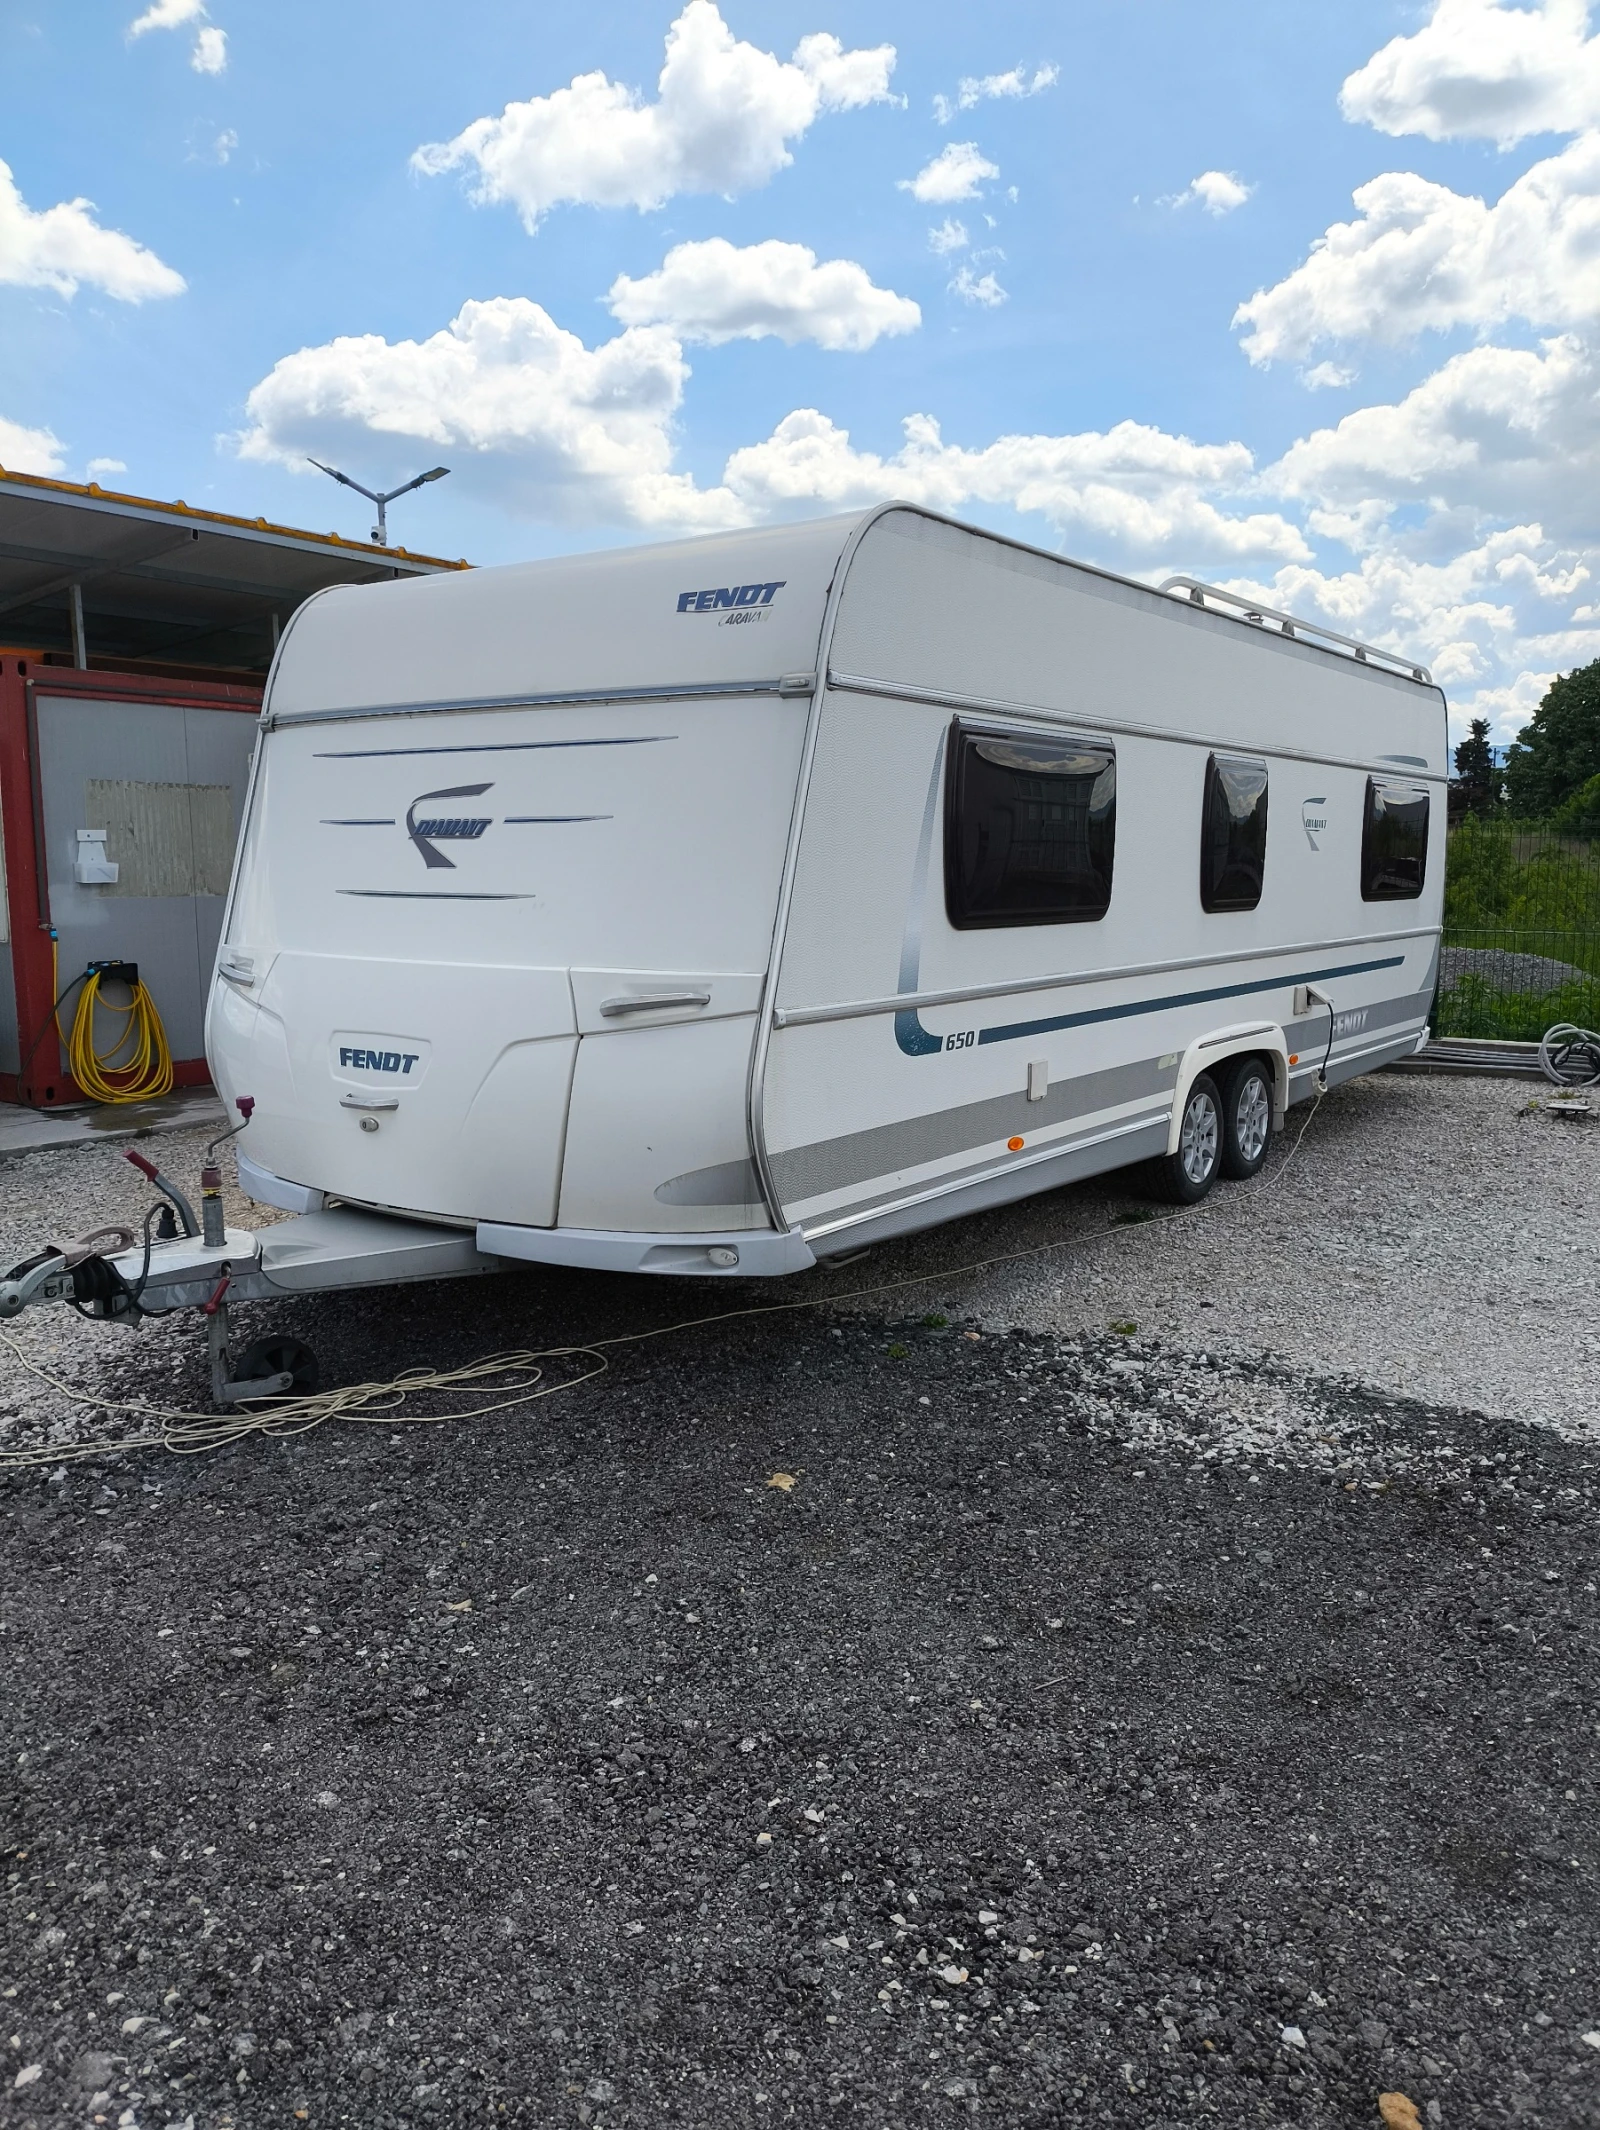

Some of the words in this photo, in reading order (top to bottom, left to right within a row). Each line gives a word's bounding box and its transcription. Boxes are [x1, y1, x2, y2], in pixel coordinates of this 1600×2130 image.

[677, 581, 787, 611] FENDT
[718, 610, 772, 627] ARAVA
[946, 1030, 975, 1051] 650
[340, 1047, 419, 1074] FENDT
